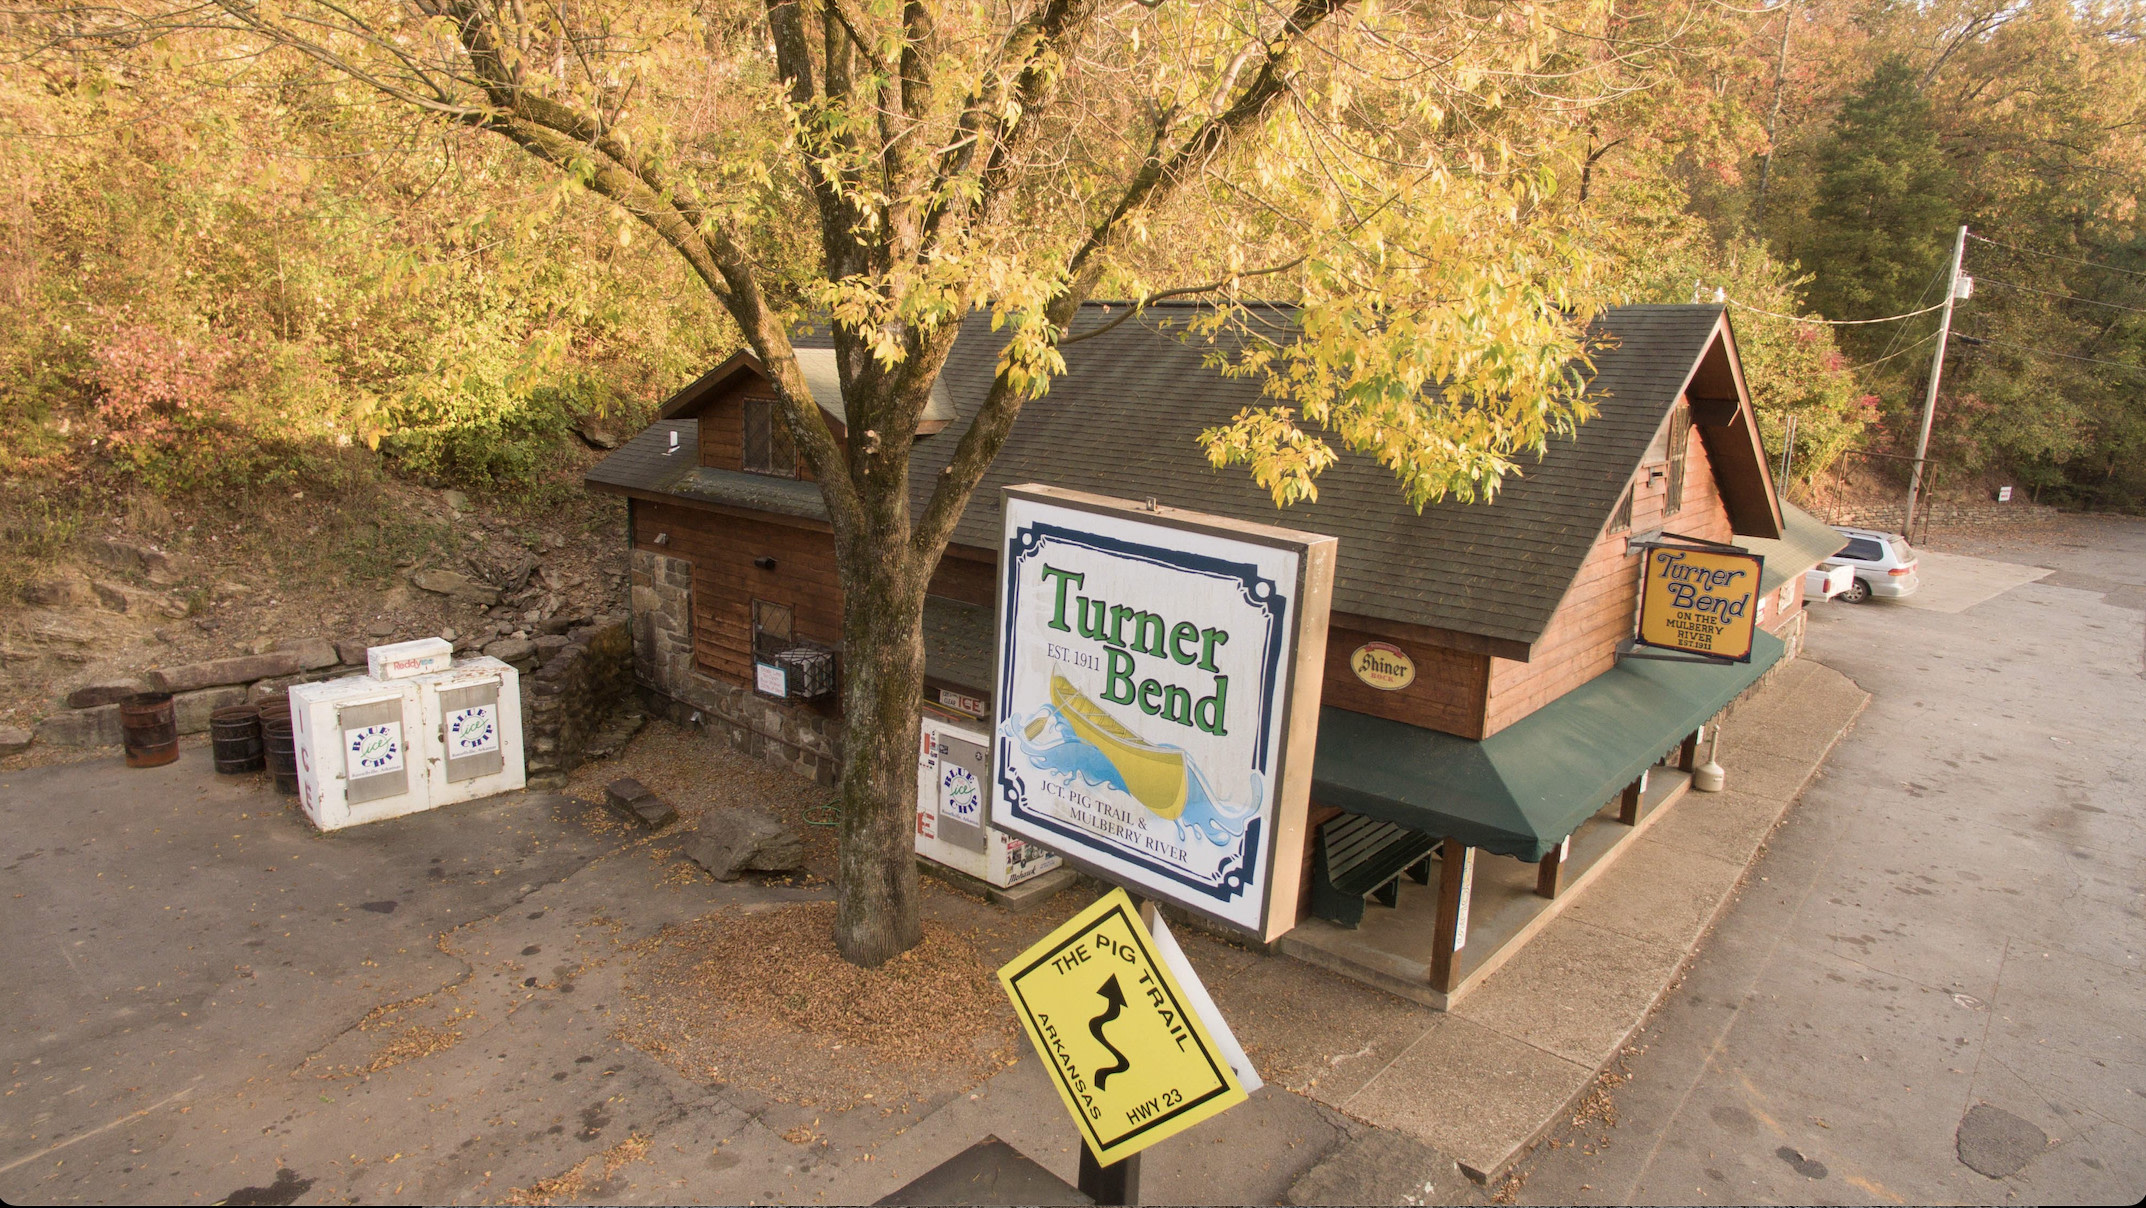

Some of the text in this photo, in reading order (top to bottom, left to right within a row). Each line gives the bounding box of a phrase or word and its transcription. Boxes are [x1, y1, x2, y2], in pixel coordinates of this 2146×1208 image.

[1657, 552, 1746, 592] Turner
[1667, 582, 1751, 625] Bend
[1041, 563, 1229, 674] Turner
[1666, 618, 1724, 635] MULBERRY
[1677, 611, 1718, 625] ON THE
[1677, 630, 1712, 643] RIVER
[1047, 643, 1100, 672] EST. 1911
[1358, 653, 1408, 678] Shiner
[1100, 645, 1229, 737] Bend
[958, 695, 981, 713] ICE
[452, 708, 487, 732] BLUE
[460, 718, 489, 738] ice
[352, 725, 390, 752] BLUE
[360, 736, 393, 758] ice
[461, 724, 493, 748] CHIP
[361, 742, 397, 768] CHIP
[944, 767, 974, 788] BLUE
[950, 784, 976, 796] ice
[950, 795, 978, 814] CHIP
[1041, 780, 1148, 831] JCT. PIG TRAIL &
[1070, 807, 1188, 863] MULBERRY RIVER
[1051, 933, 1188, 1053] THE PIG TRAIL
[1037, 1013, 1102, 1120] ARKANSAS
[1125, 1088, 1183, 1125] HWY 23
